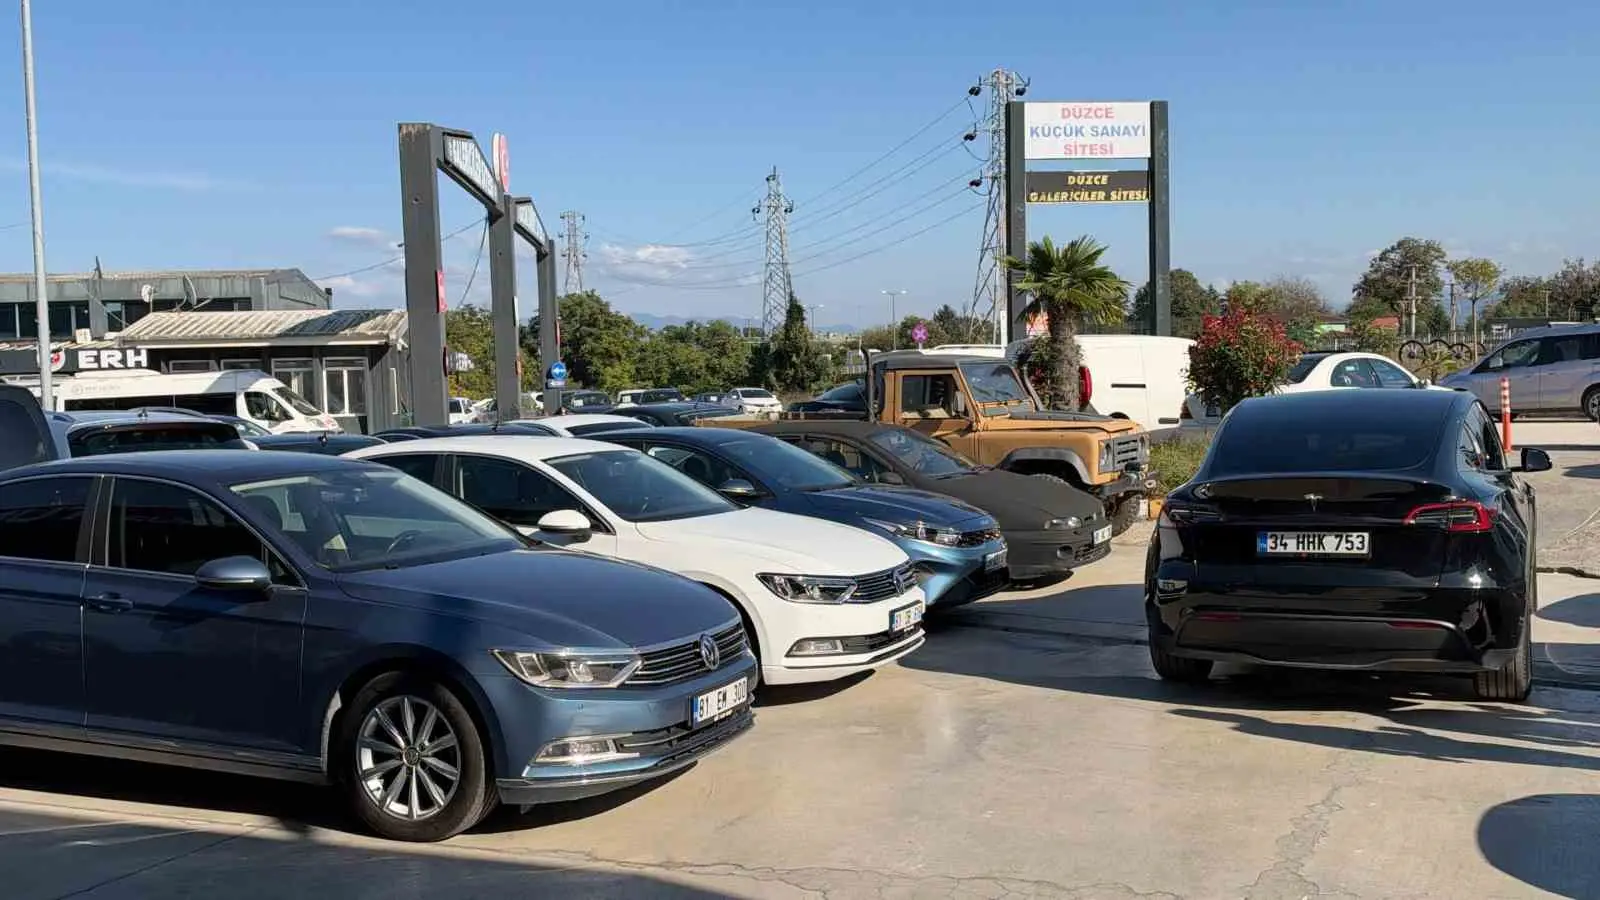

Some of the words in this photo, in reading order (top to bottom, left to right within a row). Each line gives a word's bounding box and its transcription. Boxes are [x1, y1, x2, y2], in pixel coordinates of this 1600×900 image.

[1061, 105, 1115, 119] DÜZCE
[1029, 123, 1085, 138] KÜÇÜK
[1090, 123, 1146, 137] SANAYİ
[1063, 141, 1114, 156] SİTESİ
[1067, 172, 1109, 185] DÜZCE
[1029, 188, 1106, 202] GALERİCİLER
[1110, 188, 1148, 201] SİTESİ
[78, 349, 147, 369] ERH
[1269, 534, 1288, 551] 34
[1296, 534, 1326, 551] HHK
[1334, 534, 1365, 551] 753
[699, 696, 709, 718] 81
[733, 680, 747, 703] 300
